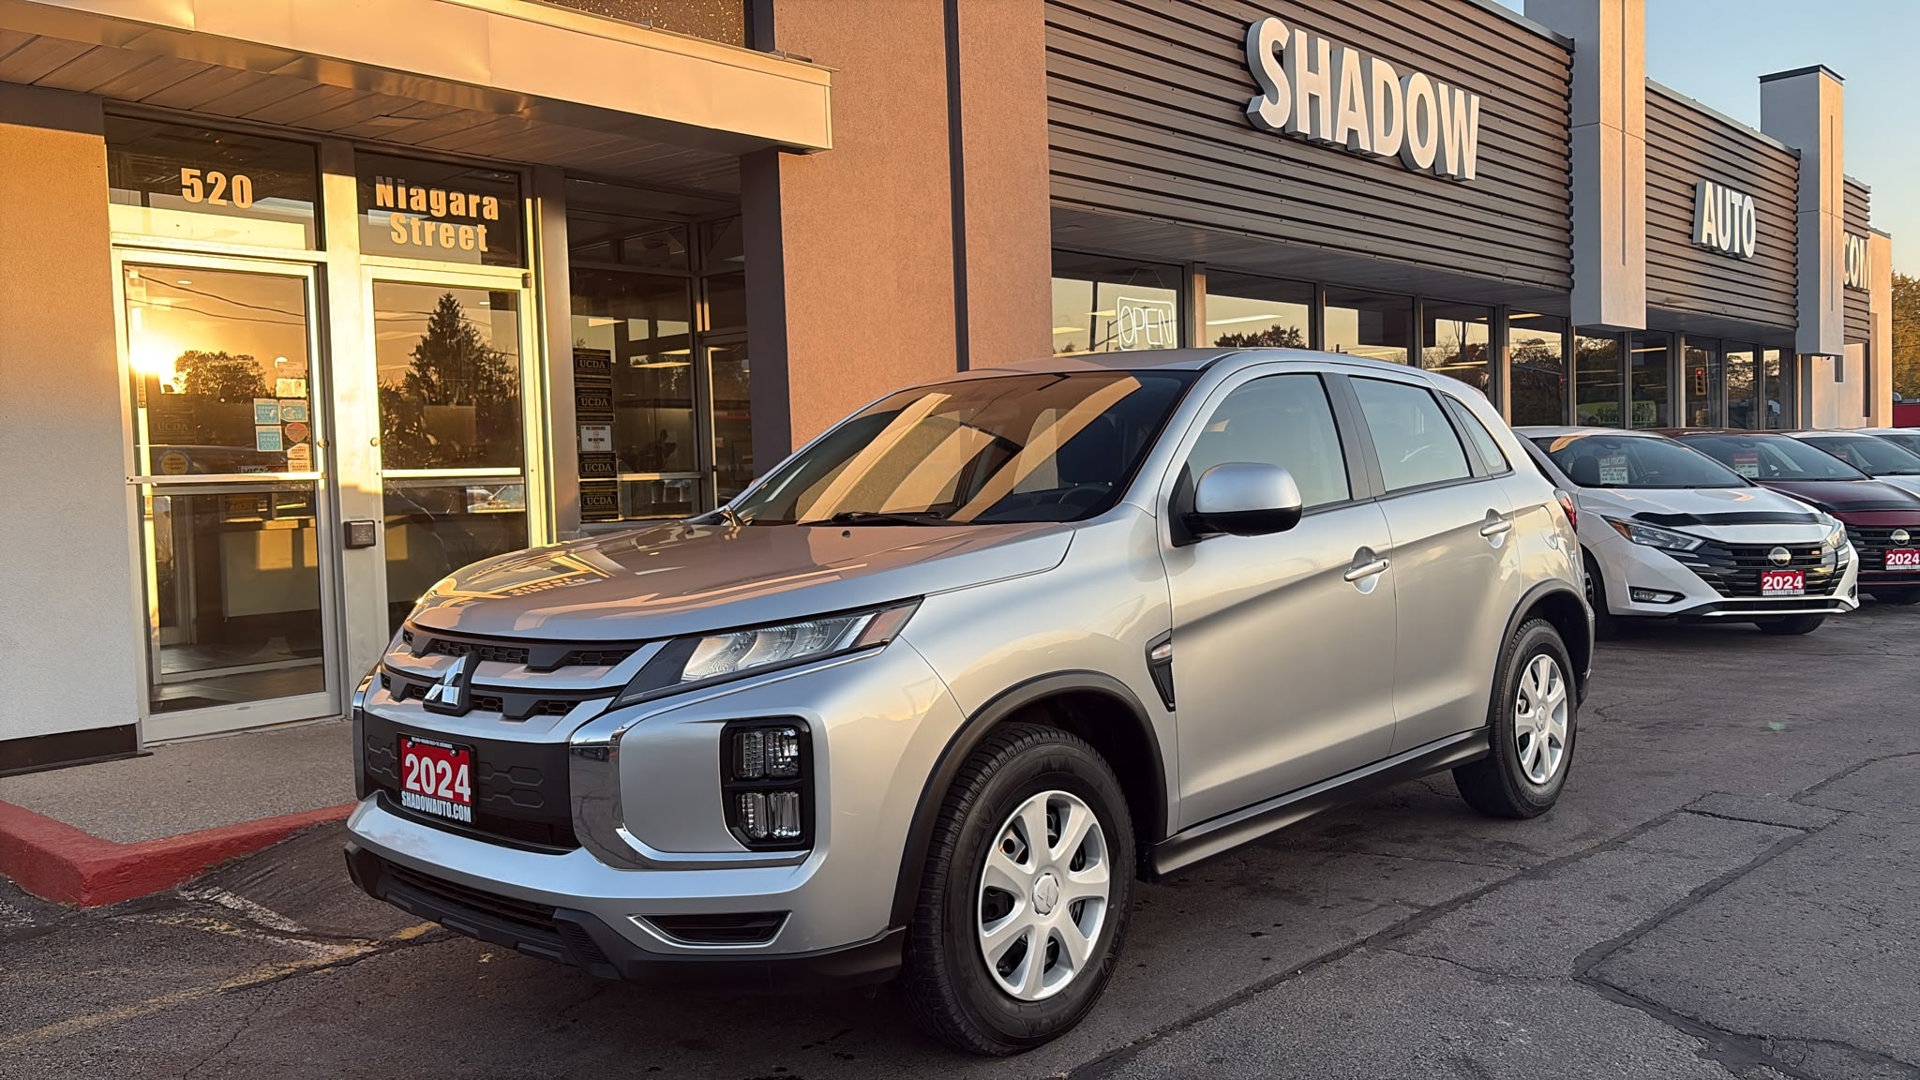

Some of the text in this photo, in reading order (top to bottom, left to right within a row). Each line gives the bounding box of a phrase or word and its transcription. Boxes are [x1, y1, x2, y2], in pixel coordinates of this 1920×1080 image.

[1246, 17, 1480, 181] SHADOW
[181, 167, 253, 209] 520
[375, 175, 499, 221] Niagara
[389, 212, 488, 252] Street
[1693, 180, 1757, 259] AUTO
[1120, 305, 1173, 345] OPEN
[580, 359, 606, 369] UCDA
[581, 397, 608, 407] UCDA
[584, 463, 612, 472] UCDA
[586, 496, 613, 505] UCDA
[1886, 553, 1920, 566] 2024
[1763, 575, 1804, 590] 2024
[405, 753, 471, 803] 2024
[401, 790, 472, 823] SHADOWAUTO.COM
